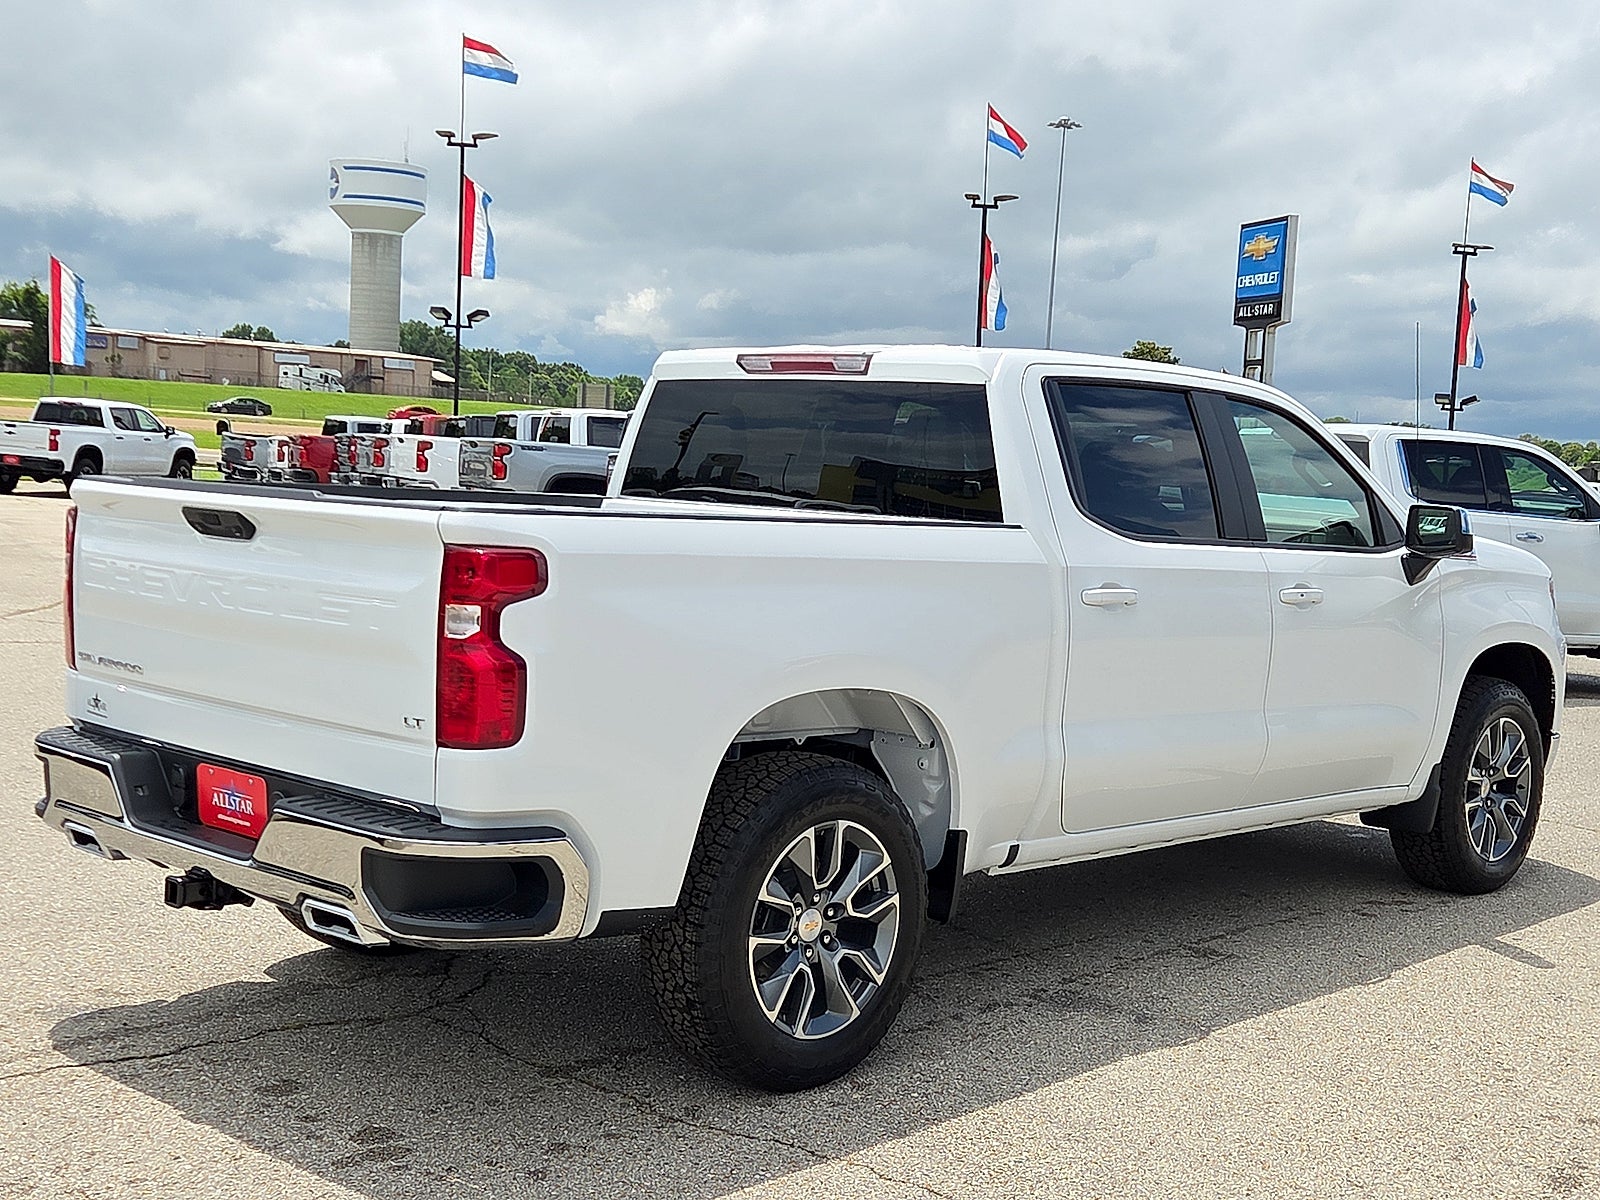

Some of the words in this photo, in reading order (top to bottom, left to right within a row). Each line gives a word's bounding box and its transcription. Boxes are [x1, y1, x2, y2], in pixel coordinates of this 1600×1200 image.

[1238, 271, 1279, 288] CHEVROLET
[1239, 303, 1274, 317] ALL-STAR
[403, 716, 426, 730] LT
[212, 792, 254, 816] ALLSTAR
